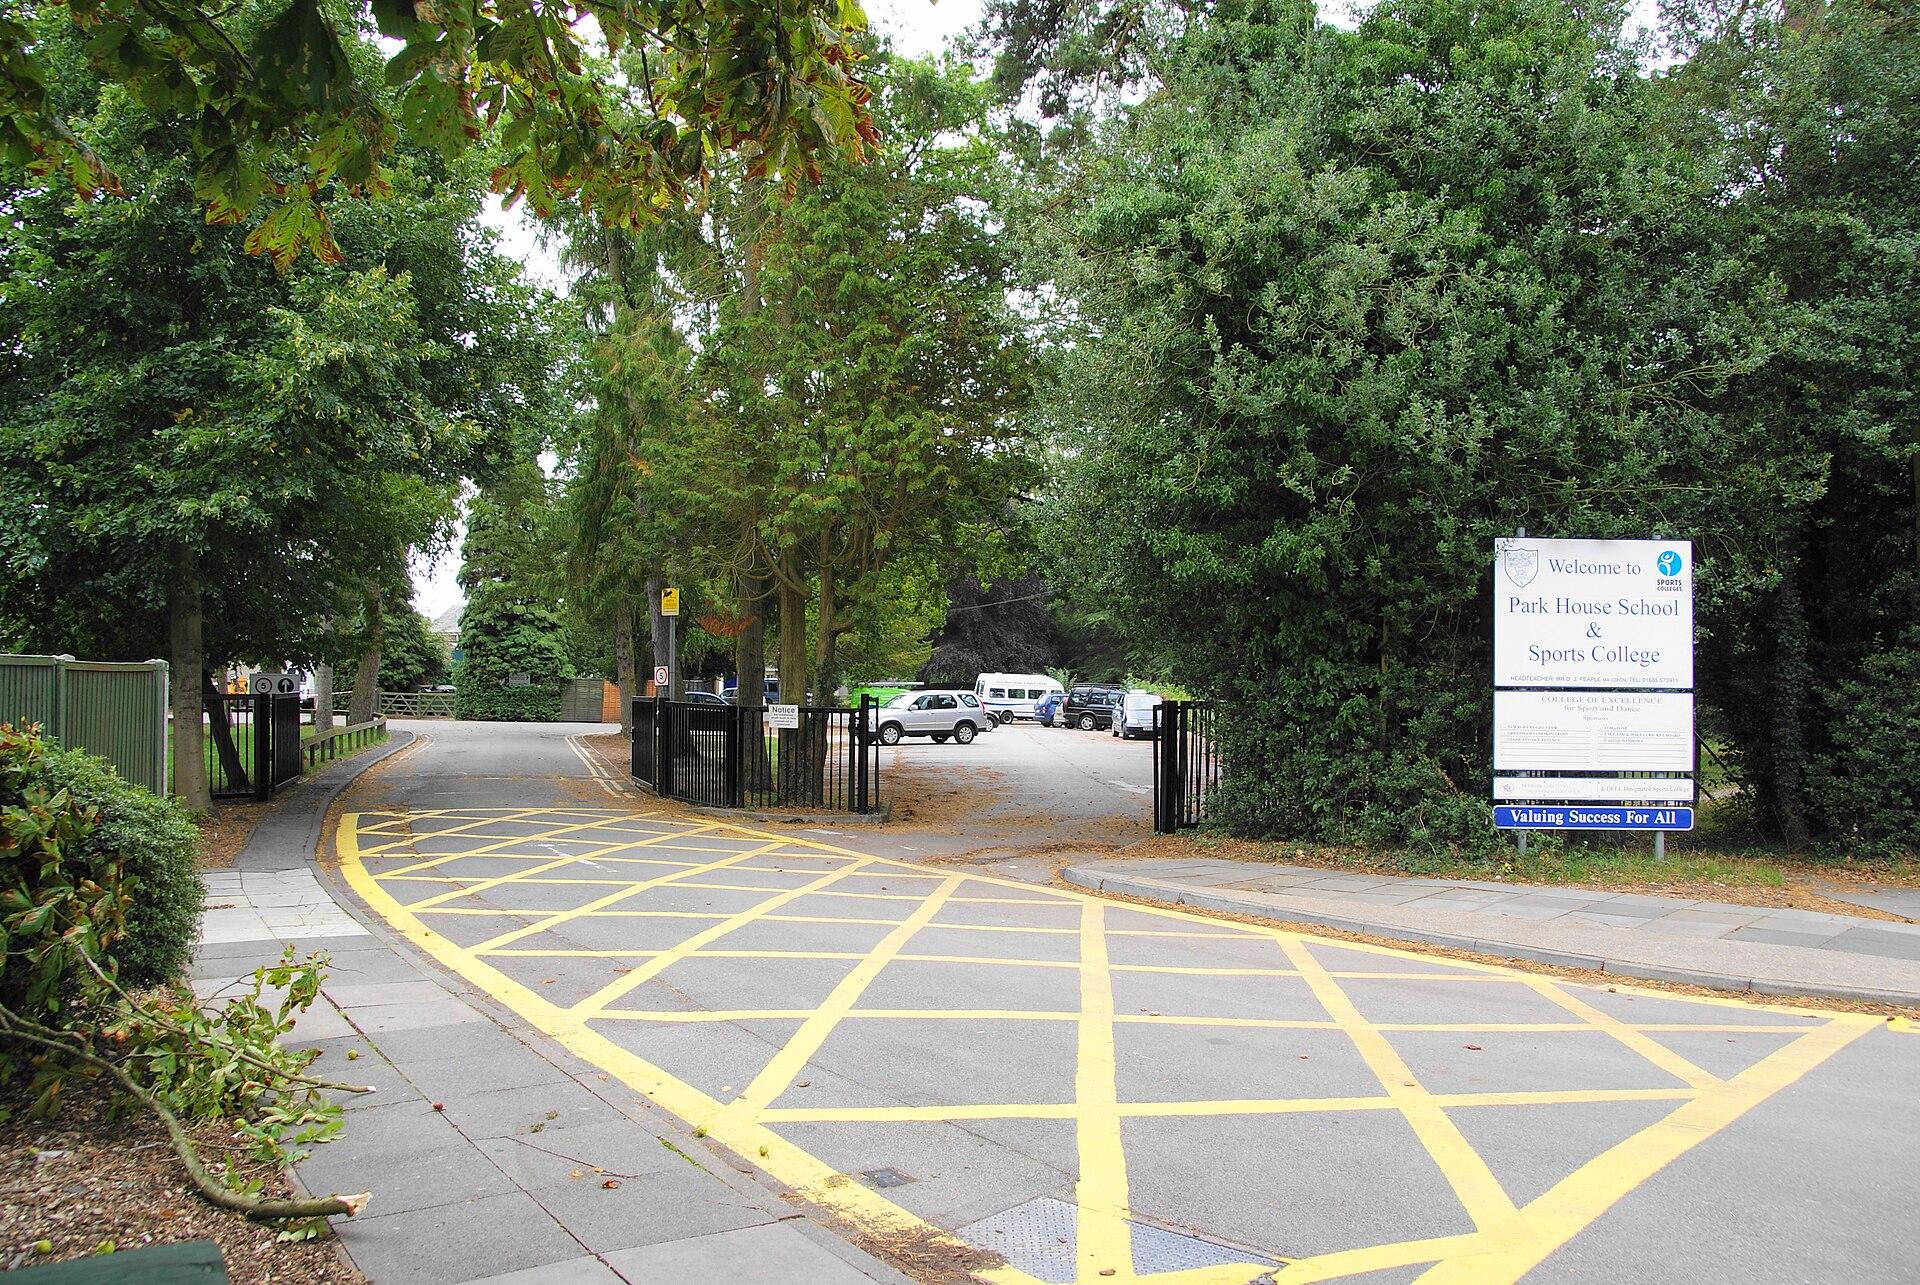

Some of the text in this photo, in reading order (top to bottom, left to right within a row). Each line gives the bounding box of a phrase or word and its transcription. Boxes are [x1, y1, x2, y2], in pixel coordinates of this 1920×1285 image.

[1549, 559, 1641, 575] Welcome to
[1509, 597, 1679, 616] Park House School
[1586, 621, 1602, 638] &
[1529, 645, 1660, 667] Sports College
[261, 682, 267, 690] 5
[1577, 704, 1598, 713] Sport
[1616, 705, 1641, 713] Dance
[1602, 696, 1663, 705] EXCELLENCE
[1623, 785, 1652, 794] Designated
[1510, 809, 1676, 825] Valuing Success For All
